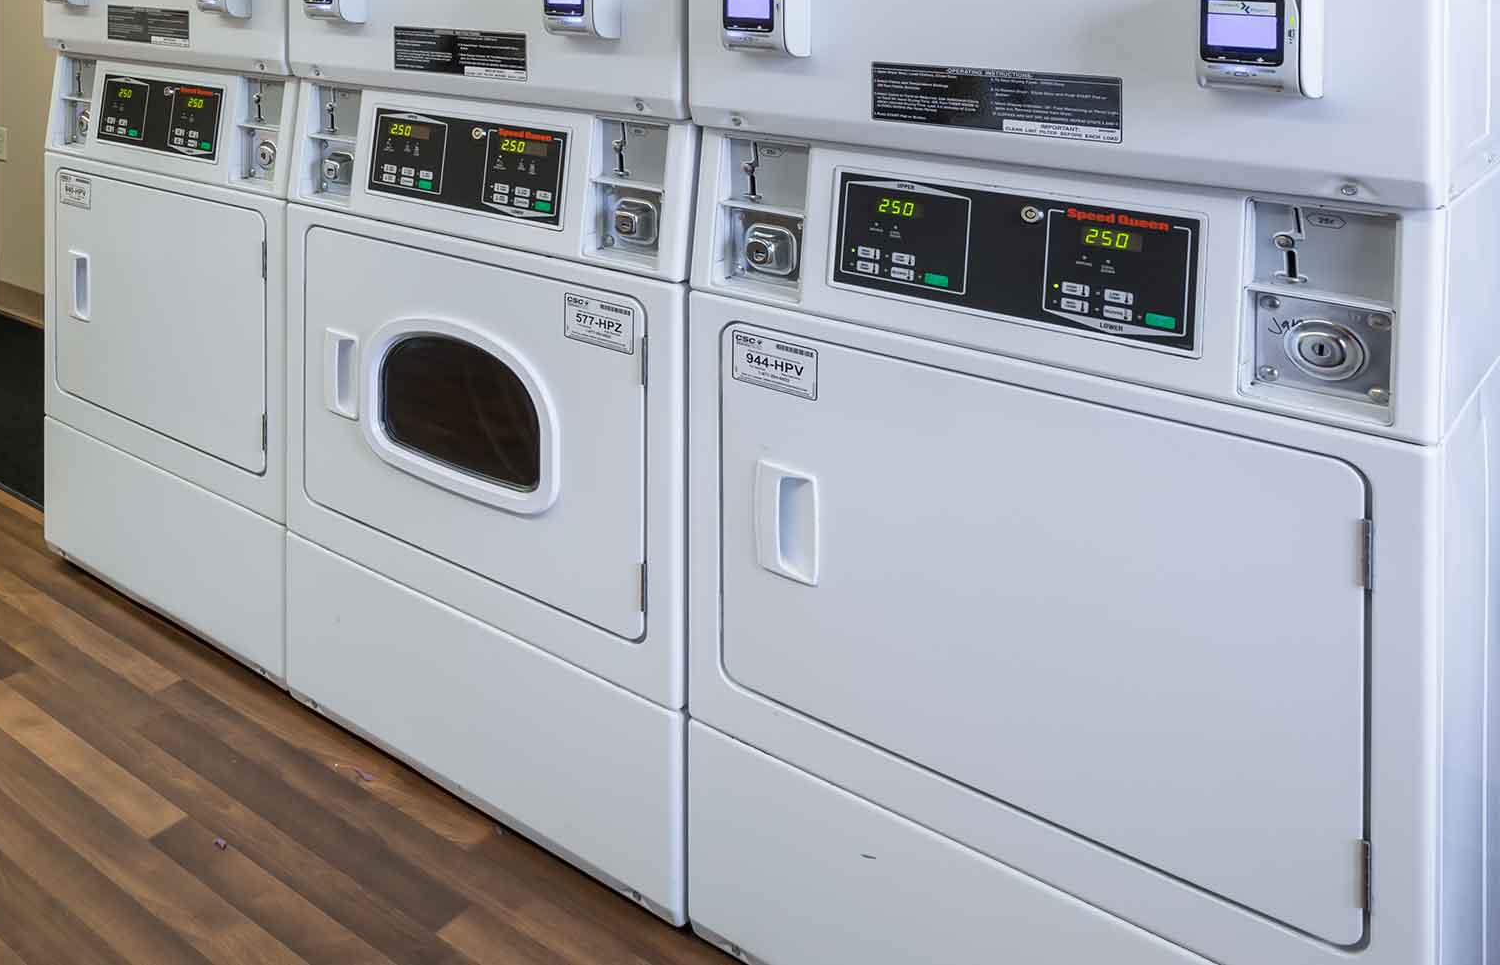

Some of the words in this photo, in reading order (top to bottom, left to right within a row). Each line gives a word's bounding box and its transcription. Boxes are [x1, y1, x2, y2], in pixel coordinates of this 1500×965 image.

[1067, 207, 1116, 224] Speed
[1118, 215, 1170, 231] Queen
[576, 313, 623, 334] 577-HPZ
[1099, 321, 1124, 332] LOWER
[746, 352, 804, 376] 944-HPV
